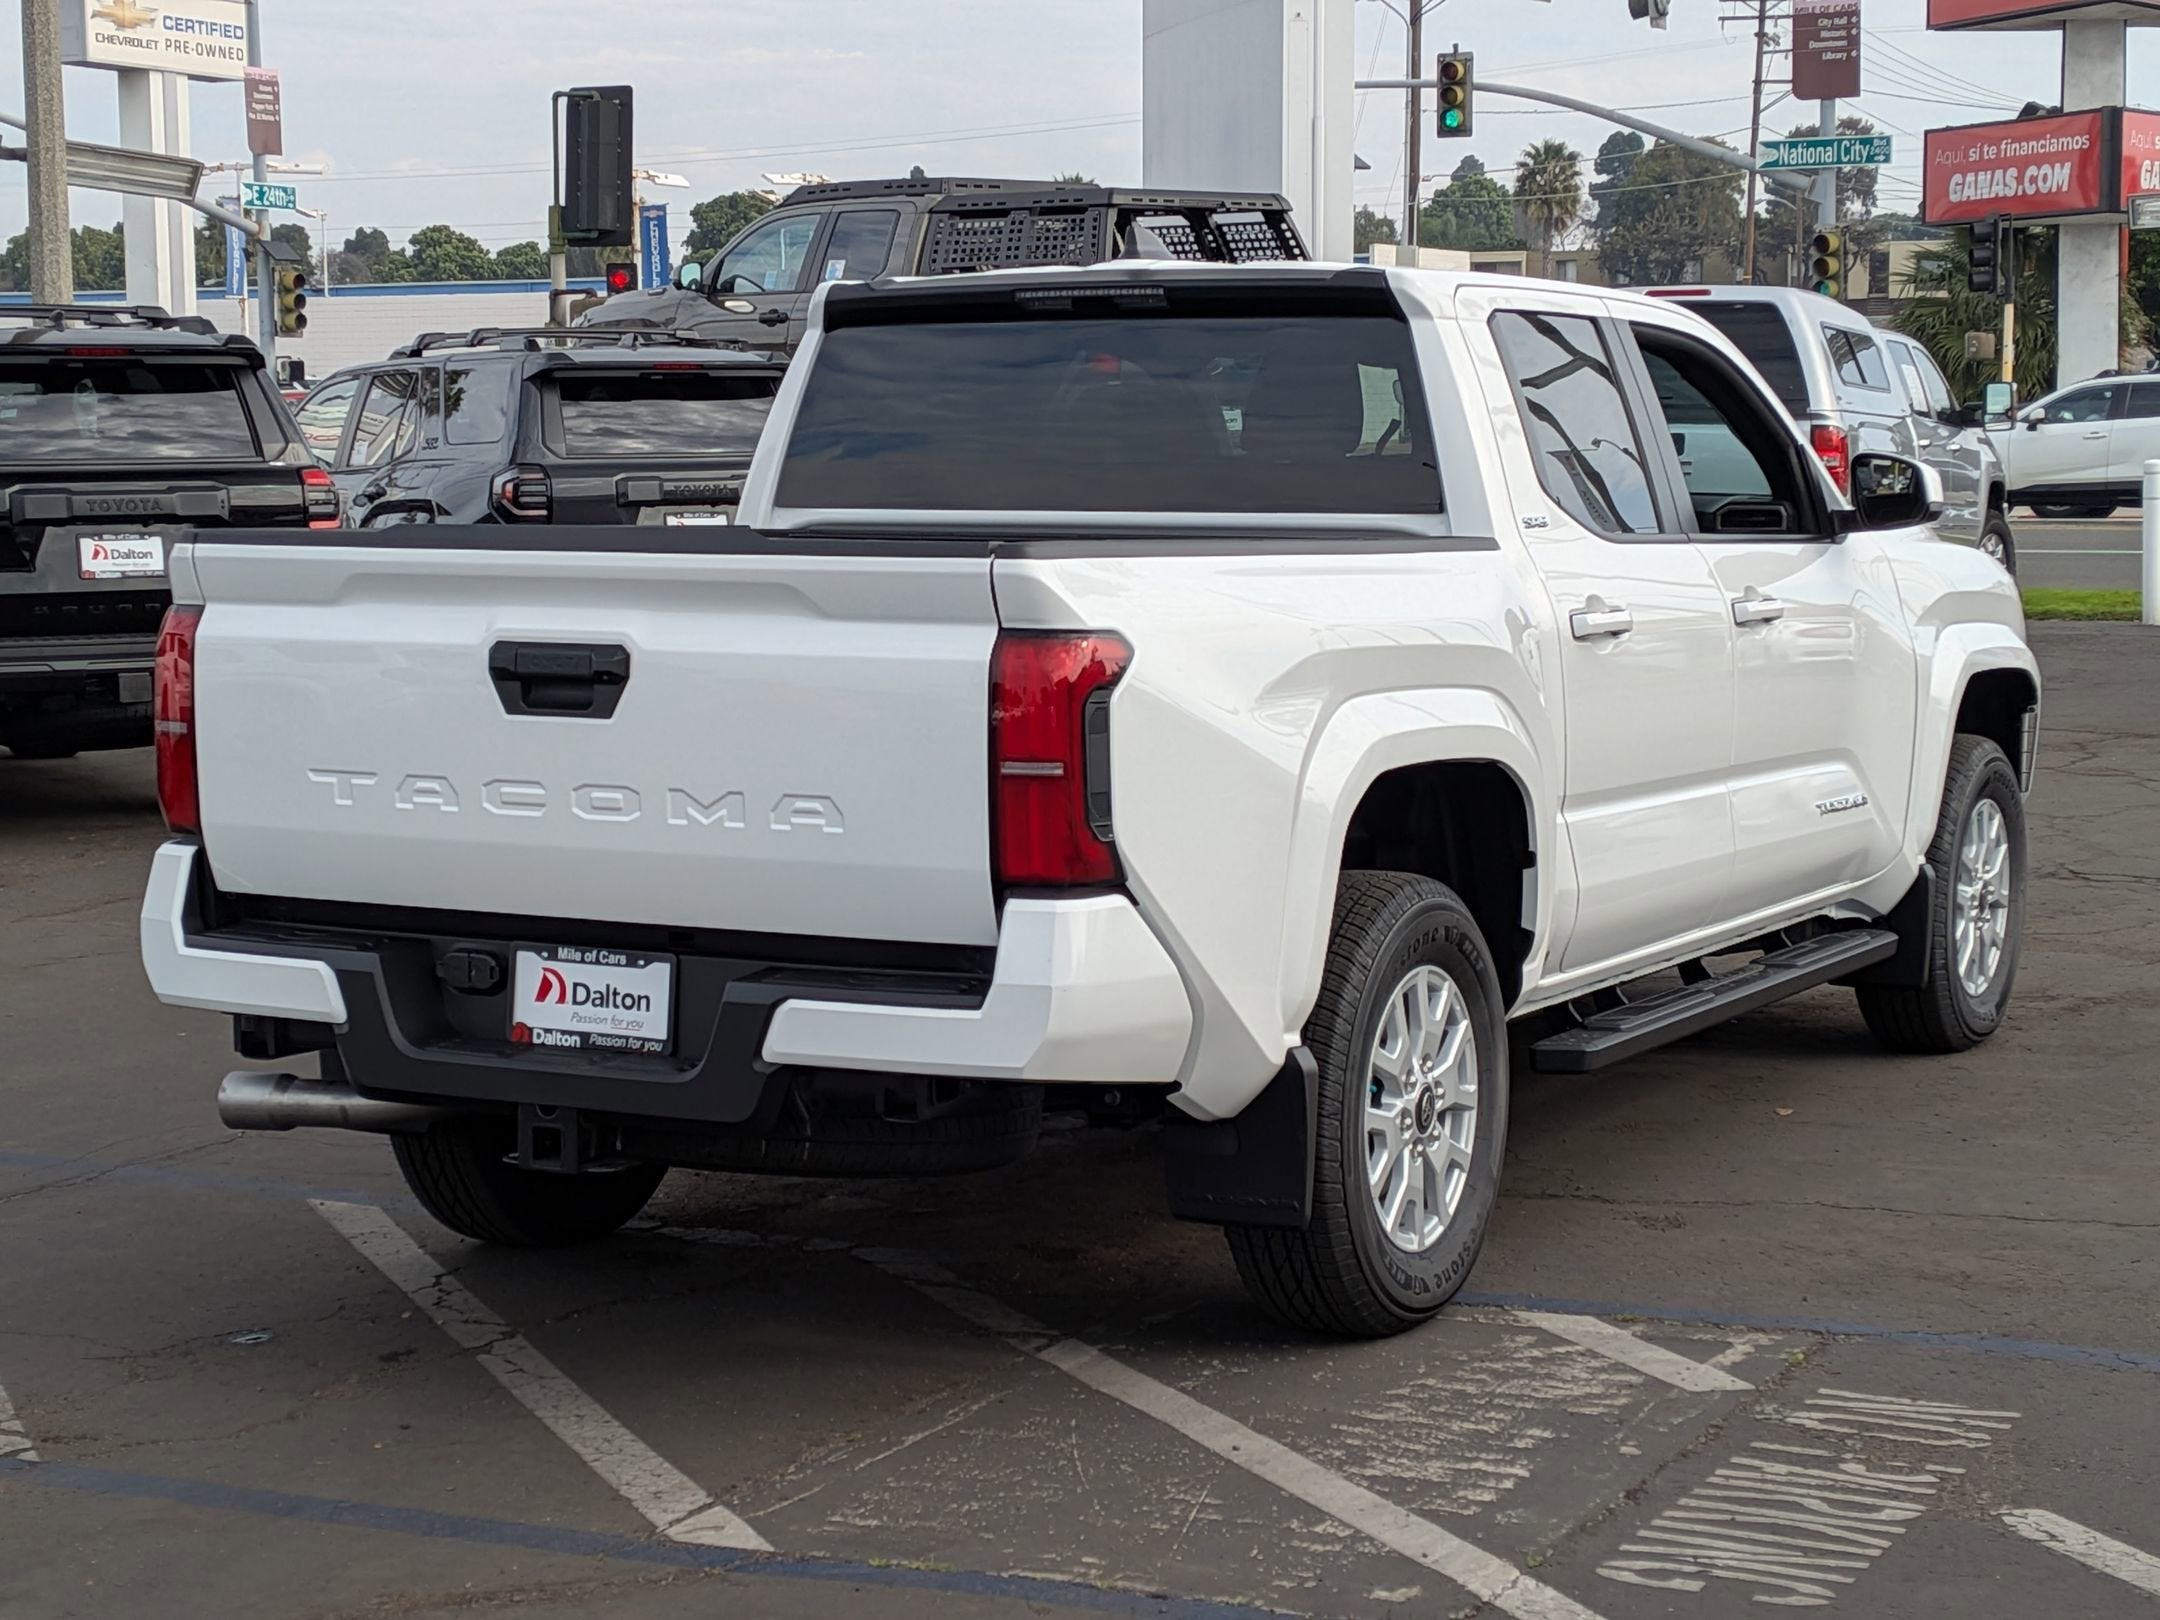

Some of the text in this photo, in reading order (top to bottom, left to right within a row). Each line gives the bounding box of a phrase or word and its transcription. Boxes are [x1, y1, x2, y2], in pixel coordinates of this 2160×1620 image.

[163, 15, 244, 40] CERTIFIED
[95, 32, 159, 50] CHEVROLET
[165, 38, 244, 61] PRE-OWNED
[1779, 140, 1870, 165] National City
[1968, 142, 1980, 162] sí
[1983, 144, 1997, 160] te
[2000, 134, 2090, 158] financiamos
[1948, 161, 2072, 203] GANAS.COM
[252, 185, 287, 207] E 24th
[673, 484, 732, 496] TOYOTA
[86, 497, 164, 513] TOYOTA
[110, 548, 153, 560] Dalton
[306, 768, 844, 834] TACOMA
[557, 946, 627, 966] Mile of Cars
[571, 982, 651, 1013] Dalton
[570, 1011, 645, 1030] Passion for you
[532, 1028, 581, 1048] Dalton
[589, 1033, 664, 1052] Passion for you
